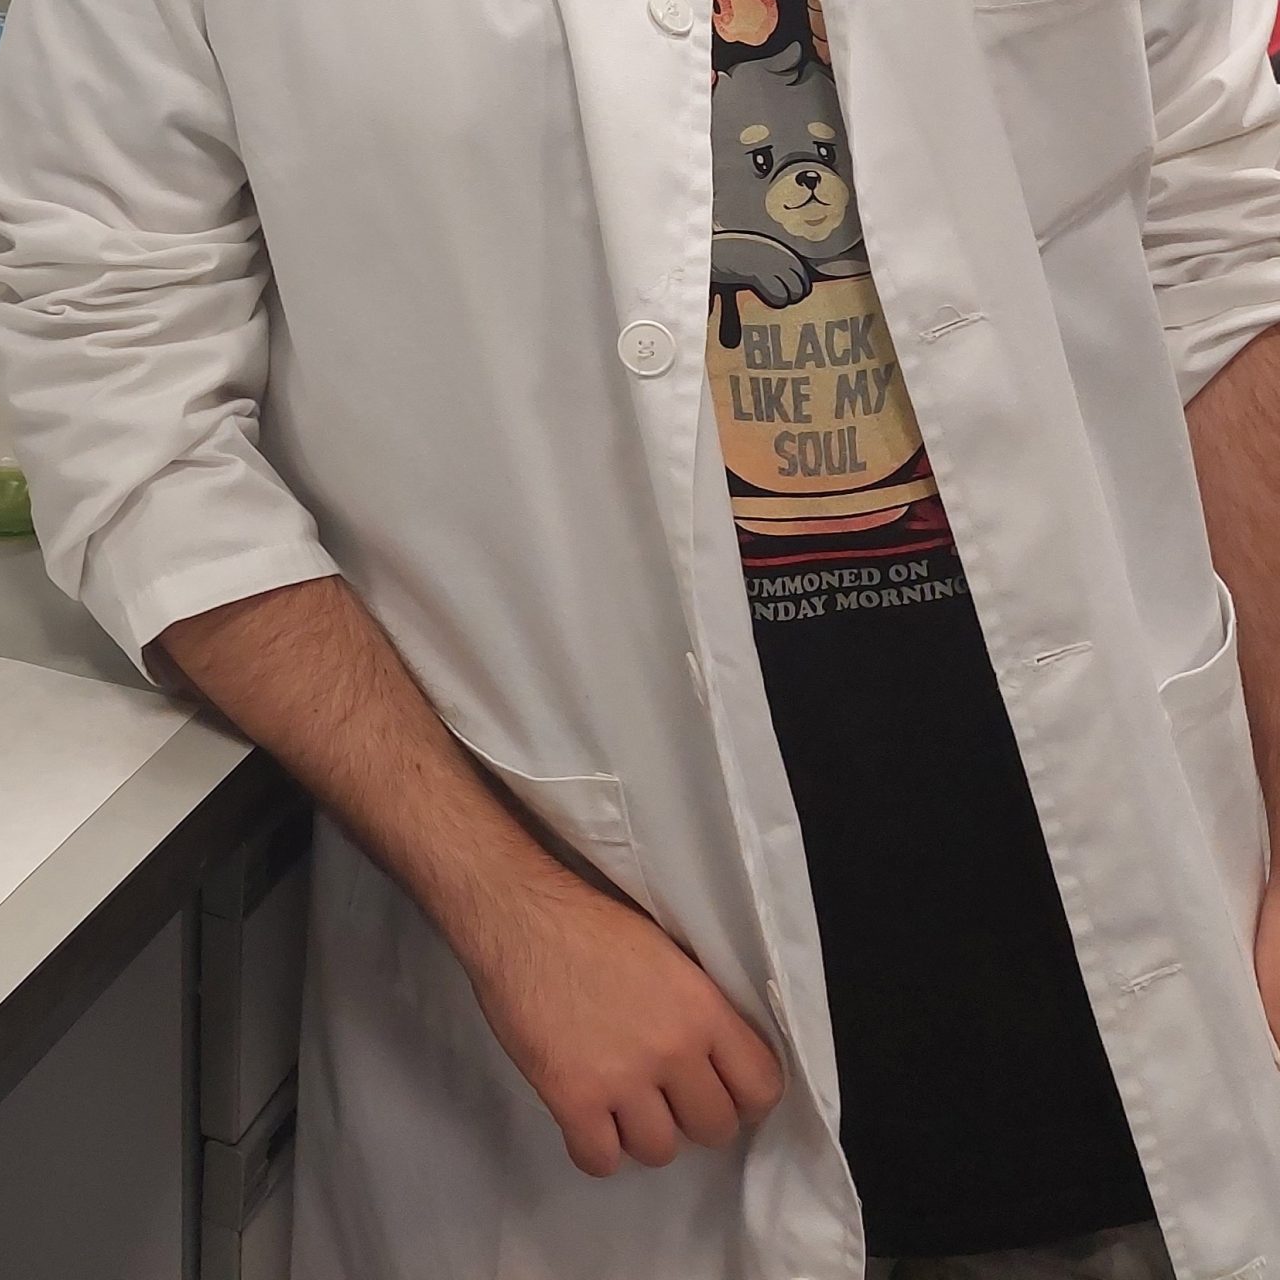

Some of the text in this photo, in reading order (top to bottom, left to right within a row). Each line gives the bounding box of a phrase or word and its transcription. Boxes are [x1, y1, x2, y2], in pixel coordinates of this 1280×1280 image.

[742, 314, 875, 371] BLACK
[729, 363, 896, 424] LIKE MY
[773, 425, 869, 478] SOUL
[887, 560, 930, 582] ON
